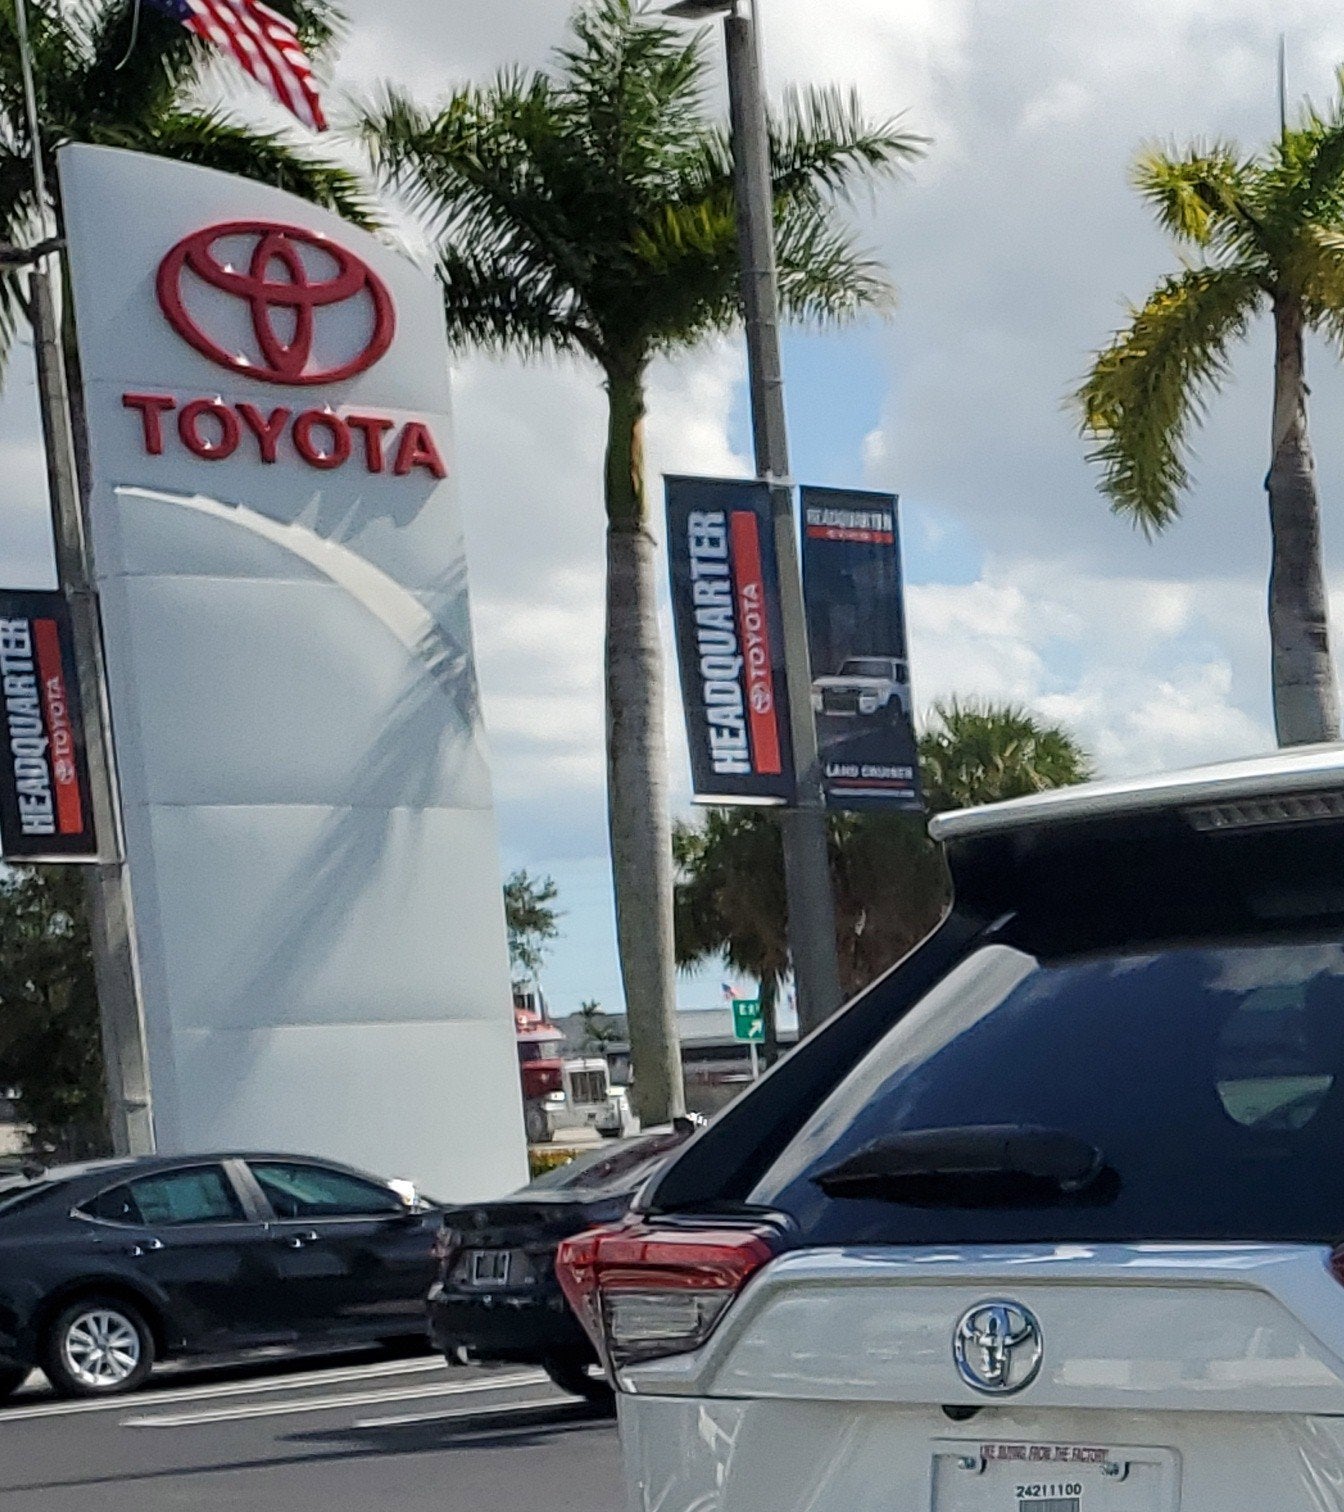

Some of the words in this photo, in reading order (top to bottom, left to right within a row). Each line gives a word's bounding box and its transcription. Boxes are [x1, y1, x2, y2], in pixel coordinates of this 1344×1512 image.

[122, 391, 448, 479] TOYOTA
[687, 510, 750, 774] HEADQUARTER
[742, 583, 768, 680] TOYOTA
[0, 617, 55, 835] HEADQUARTER
[46, 675, 75, 756] TOYOTA
[1016, 1483, 1082, 1498] 24211100
